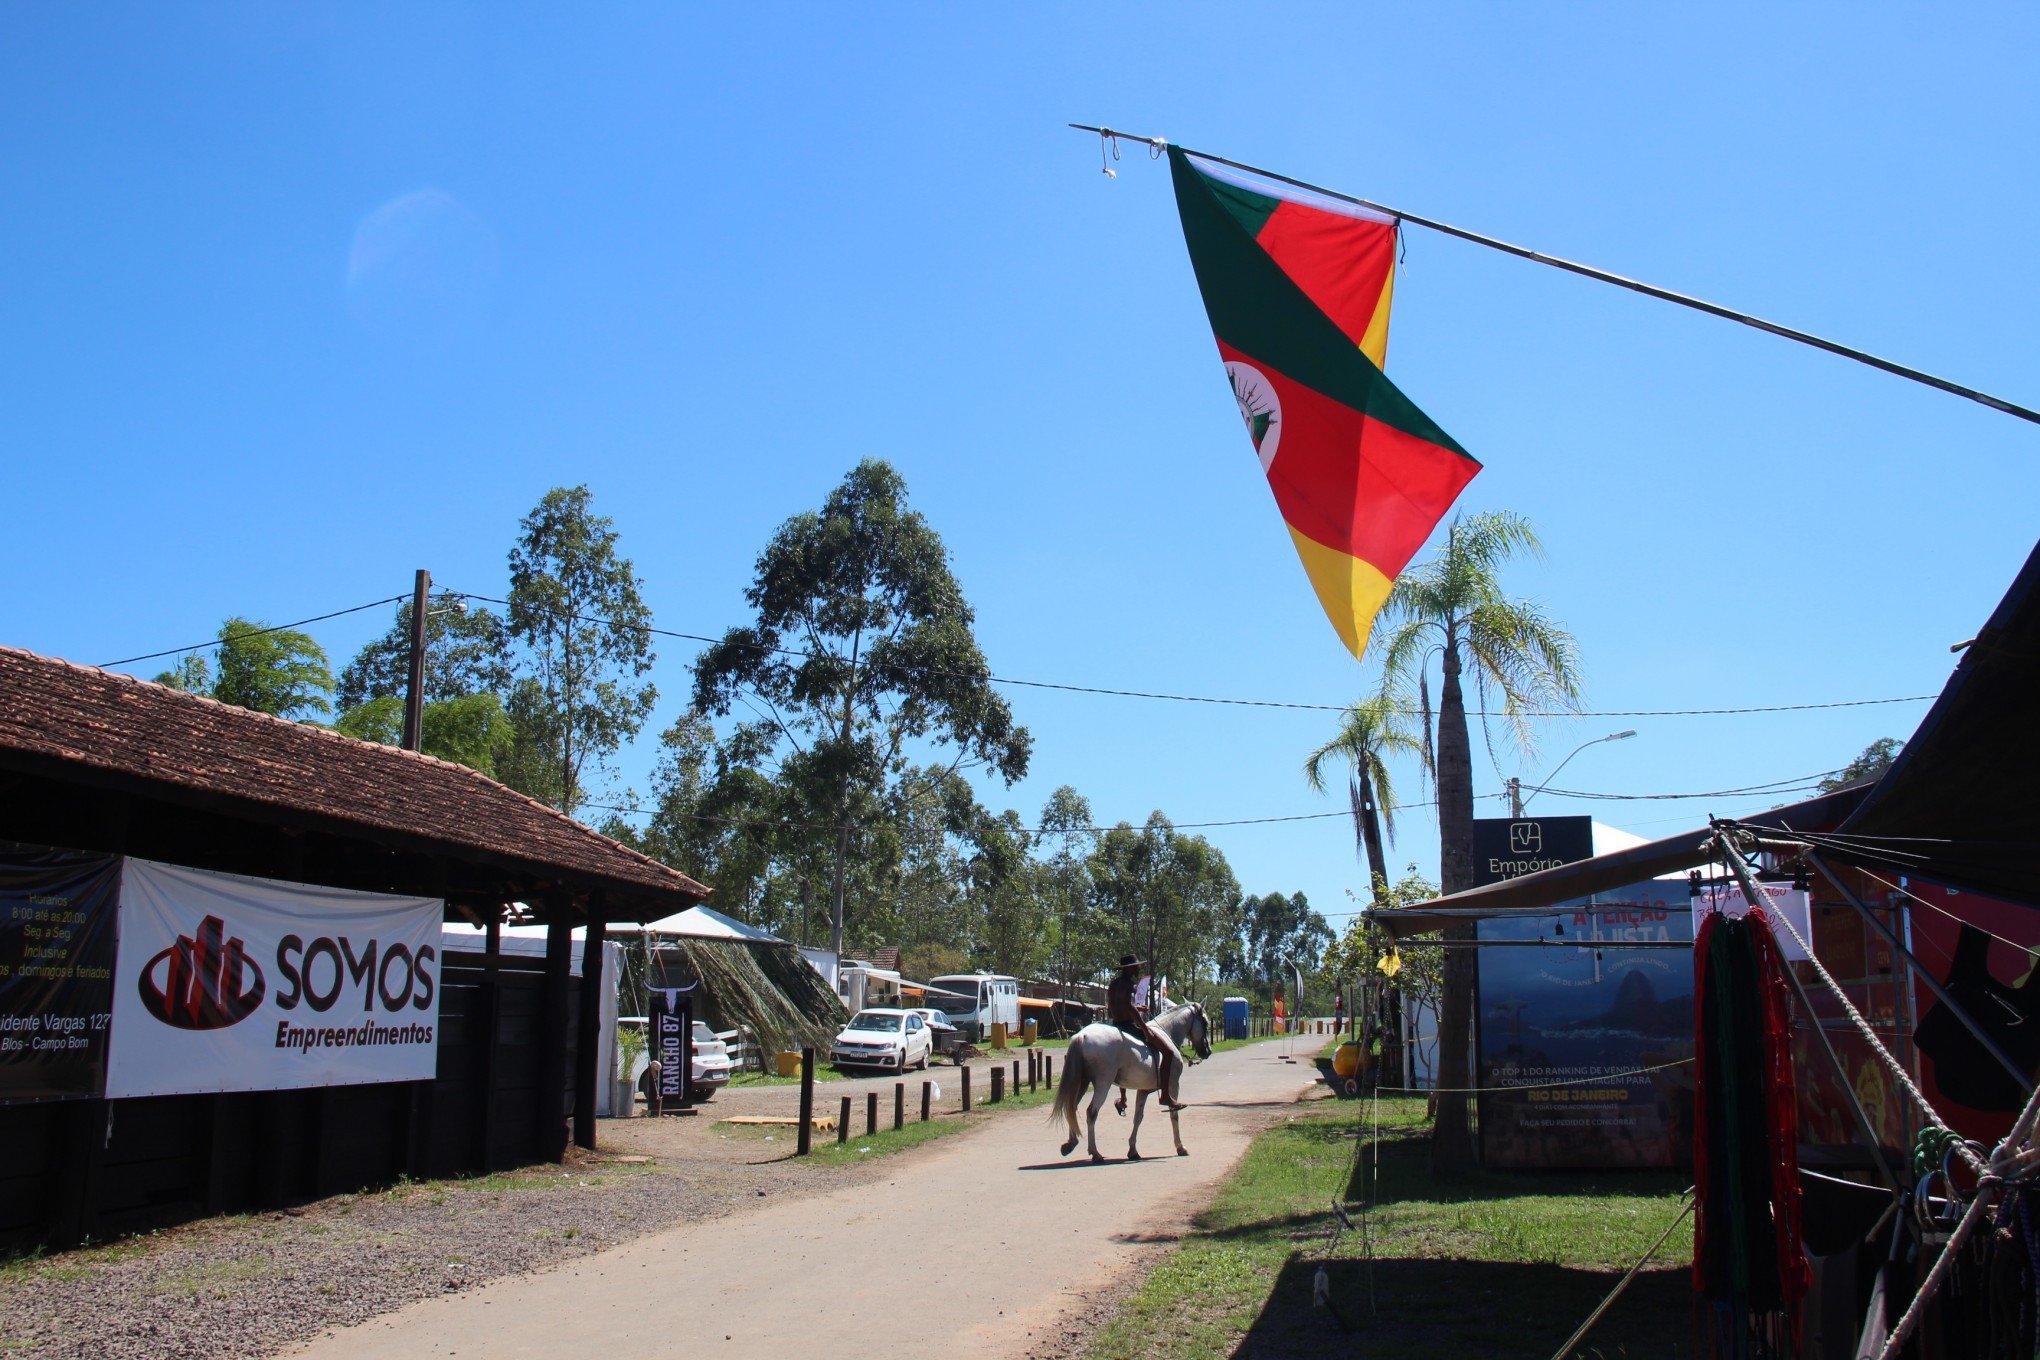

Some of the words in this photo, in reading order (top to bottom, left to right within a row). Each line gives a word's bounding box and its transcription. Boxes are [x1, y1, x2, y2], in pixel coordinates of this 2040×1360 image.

[1488, 857, 1564, 875] Empório
[35, 909, 49, 921] até
[23, 944, 69, 959] Inclusive
[18, 963, 67, 980] domingos
[275, 934, 435, 1013] SOMOS
[44, 1013, 87, 1035] Vargas
[662, 1014, 680, 1032] 87
[1, 1037, 24, 1051] Blos
[32, 1037, 66, 1052] Campo
[68, 1036, 89, 1049] Bom
[275, 1020, 433, 1054] Empreendimentos
[662, 1037, 680, 1095] RANCHO
[1502, 1067, 1520, 1076] TOP
[1529, 1067, 1543, 1076] DO
[1545, 1066, 1588, 1076] RANKING
[1589, 1066, 1602, 1075] DE
[1603, 1065, 1642, 1075] VENDAS
[1626, 1076, 1652, 1085] PARA
[1527, 1090, 1550, 1102] RIO
[1551, 1090, 1570, 1102] DE
[1571, 1089, 1629, 1102] JANEIRO
